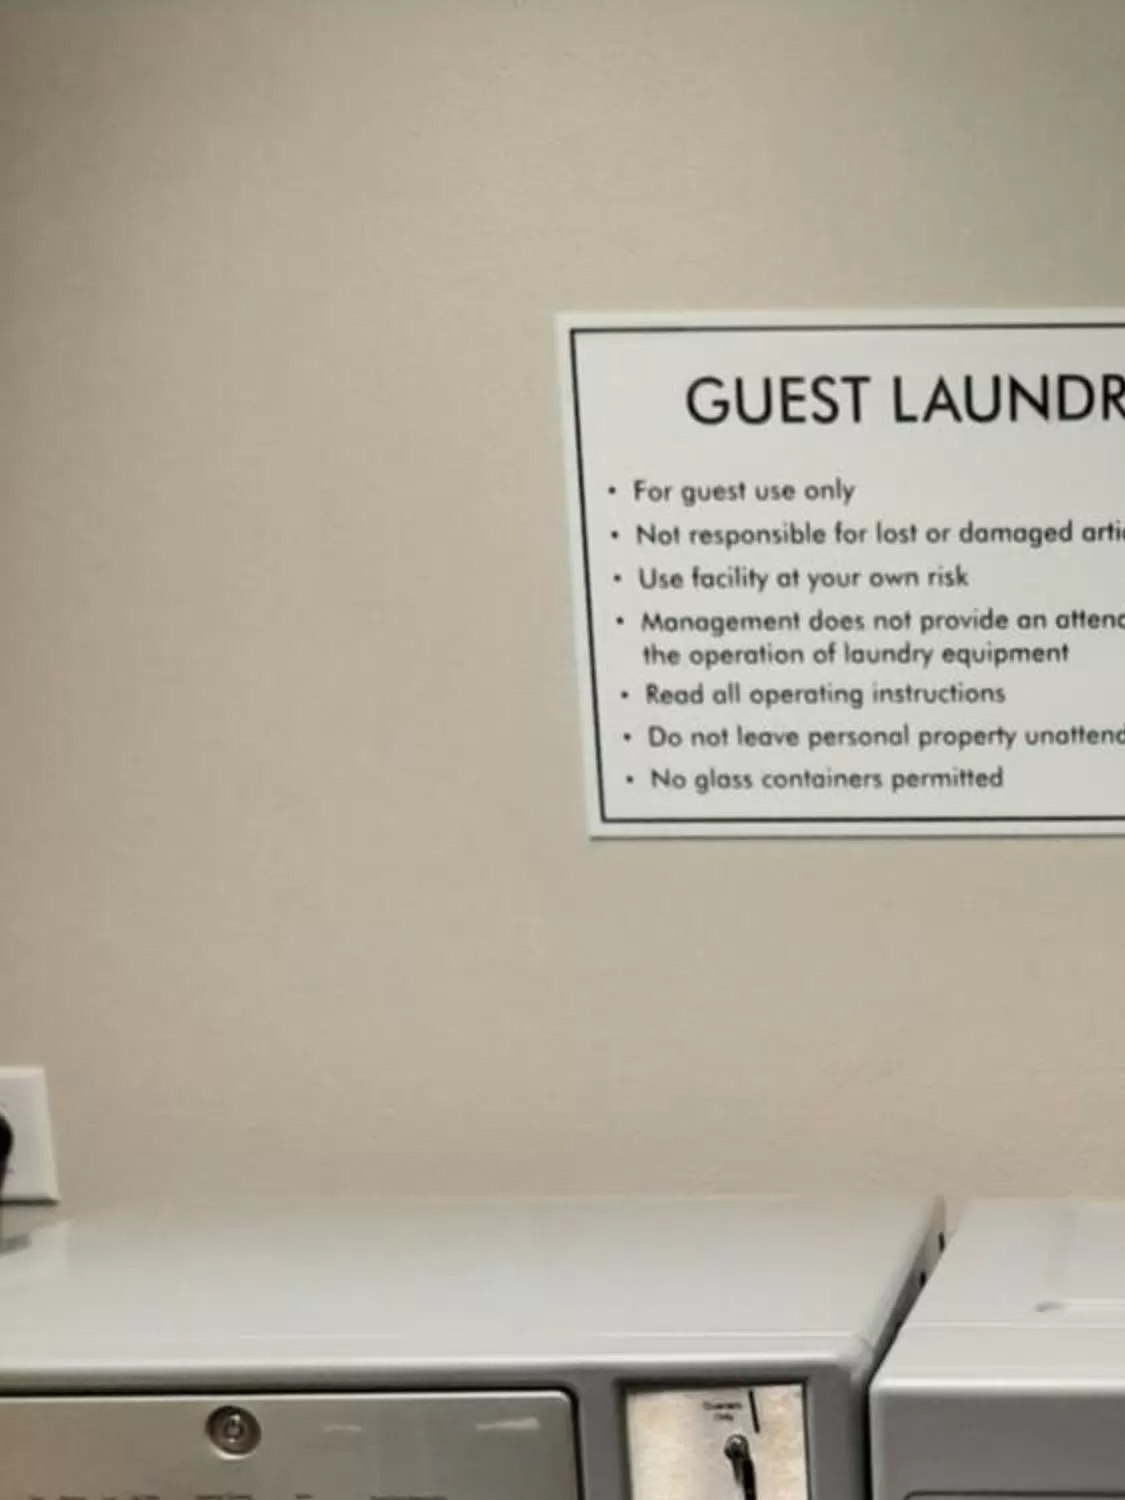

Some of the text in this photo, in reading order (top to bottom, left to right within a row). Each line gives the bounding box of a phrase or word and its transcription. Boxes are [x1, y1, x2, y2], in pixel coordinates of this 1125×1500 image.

[685, 373, 872, 427] GUEST
[632, 476, 857, 507] For guest use only
[635, 522, 681, 547] Not
[688, 520, 827, 551] responsible
[833, 520, 868, 545] for
[875, 520, 918, 545] lost
[924, 527, 952, 545] or
[958, 518, 1074, 549] damaged
[637, 563, 970, 594] Use facility at your own risk
[640, 611, 801, 637] Management
[808, 608, 865, 633] does
[872, 610, 913, 632] not
[919, 607, 1010, 635] provide
[1016, 613, 1048, 630] an
[641, 641, 1070, 670] the operation of laundry equipment
[644, 681, 1007, 710] Read all operating instructions
[647, 724, 684, 748] Do
[690, 727, 729, 748] not
[736, 724, 800, 748] leave
[807, 723, 910, 751] personal
[917, 725, 1018, 751] property
[650, 765, 1005, 795] No glass containers permitted
